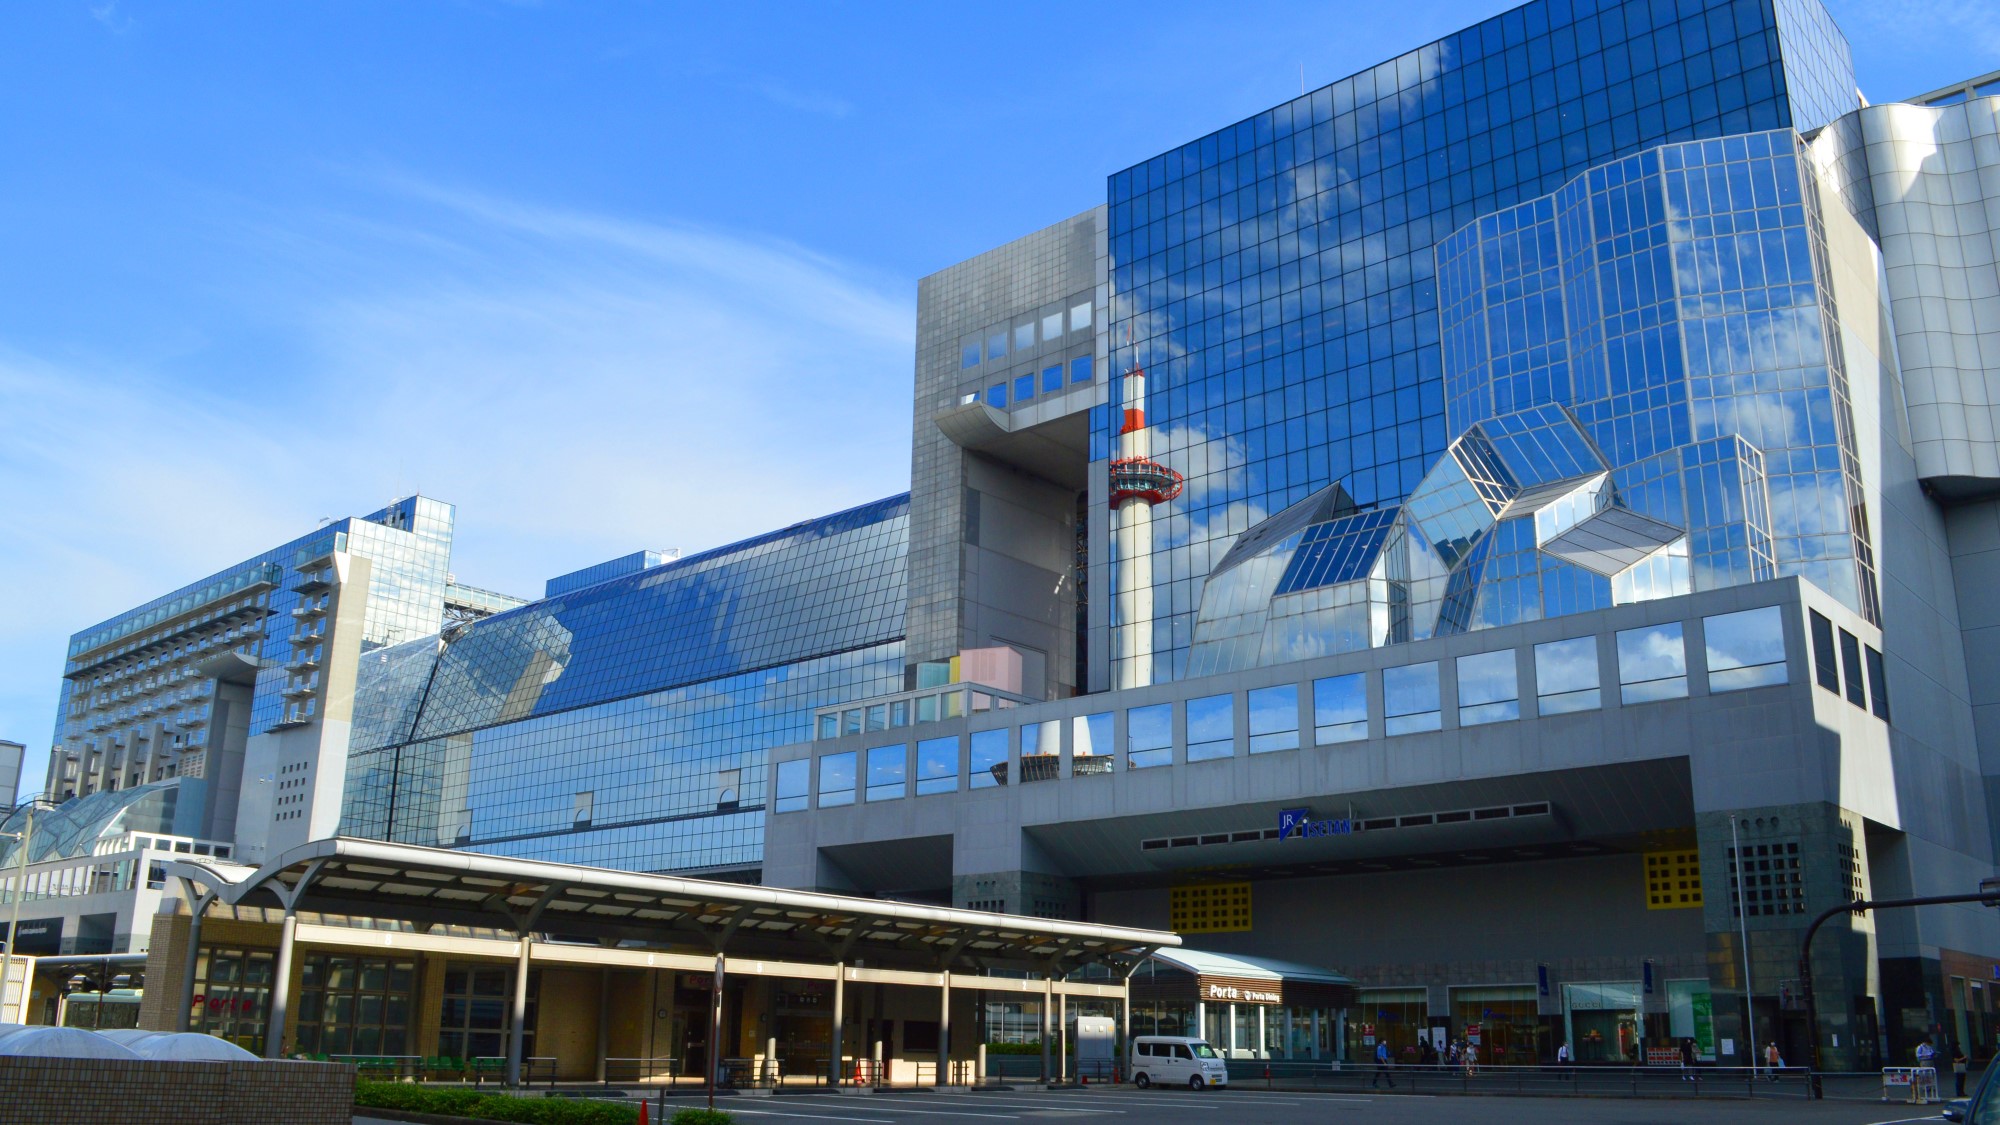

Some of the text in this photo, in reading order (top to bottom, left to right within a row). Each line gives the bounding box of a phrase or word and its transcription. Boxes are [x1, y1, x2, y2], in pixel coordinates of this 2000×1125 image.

[1282, 814, 1294, 829] JR
[385, 934, 392, 945] 8
[514, 944, 520, 955] 7
[851, 969, 856, 979] 4
[939, 975, 944, 985] 3
[1022, 980, 1027, 991] 2
[1210, 984, 1237, 998] Porta
[1252, 992, 1280, 1003] Porta Dining
